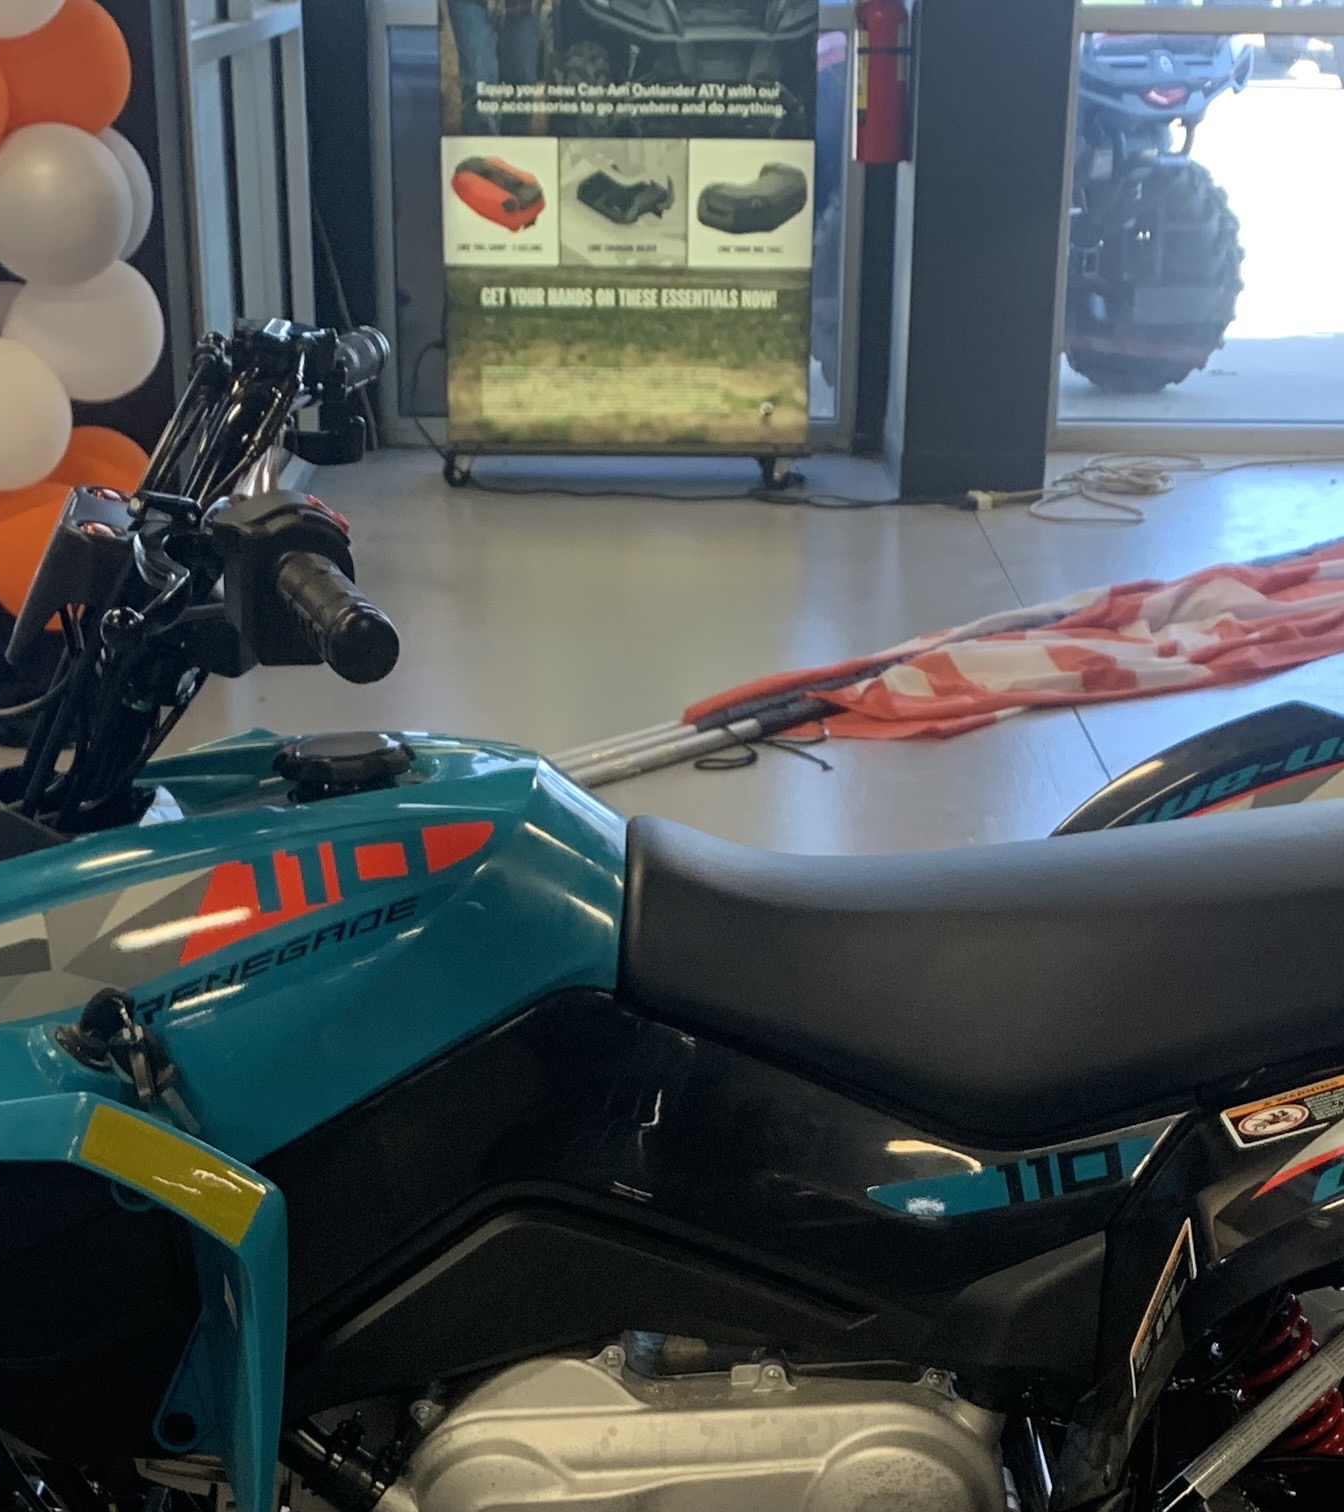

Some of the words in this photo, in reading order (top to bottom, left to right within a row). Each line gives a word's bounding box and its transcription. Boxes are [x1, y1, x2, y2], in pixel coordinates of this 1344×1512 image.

[476, 81, 514, 98] Equip
[516, 83, 545, 98] your
[547, 84, 575, 96] new
[632, 82, 696, 97] Outlander
[698, 83, 726, 97] ATV
[727, 83, 756, 98] with
[758, 85, 781, 99] our
[476, 100, 499, 114] top
[501, 101, 578, 114] accessories
[580, 101, 595, 114] to
[596, 102, 614, 116] go
[615, 101, 679, 117] anywhere
[681, 101, 706, 114] and
[708, 101, 725, 114] do
[727, 102, 787, 118] anything.
[480, 287, 506, 307] GET
[509, 287, 546, 307] YOUR
[547, 287, 593, 307] HANDS
[595, 287, 616, 307] ON
[618, 288, 658, 308] THESE
[661, 288, 738, 308] ESSENTIALS
[741, 289, 778, 309] NOW!
[239, 829, 430, 914] 110
[135, 895, 421, 1028] RENEGADE
[996, 1142, 1124, 1205] 110
